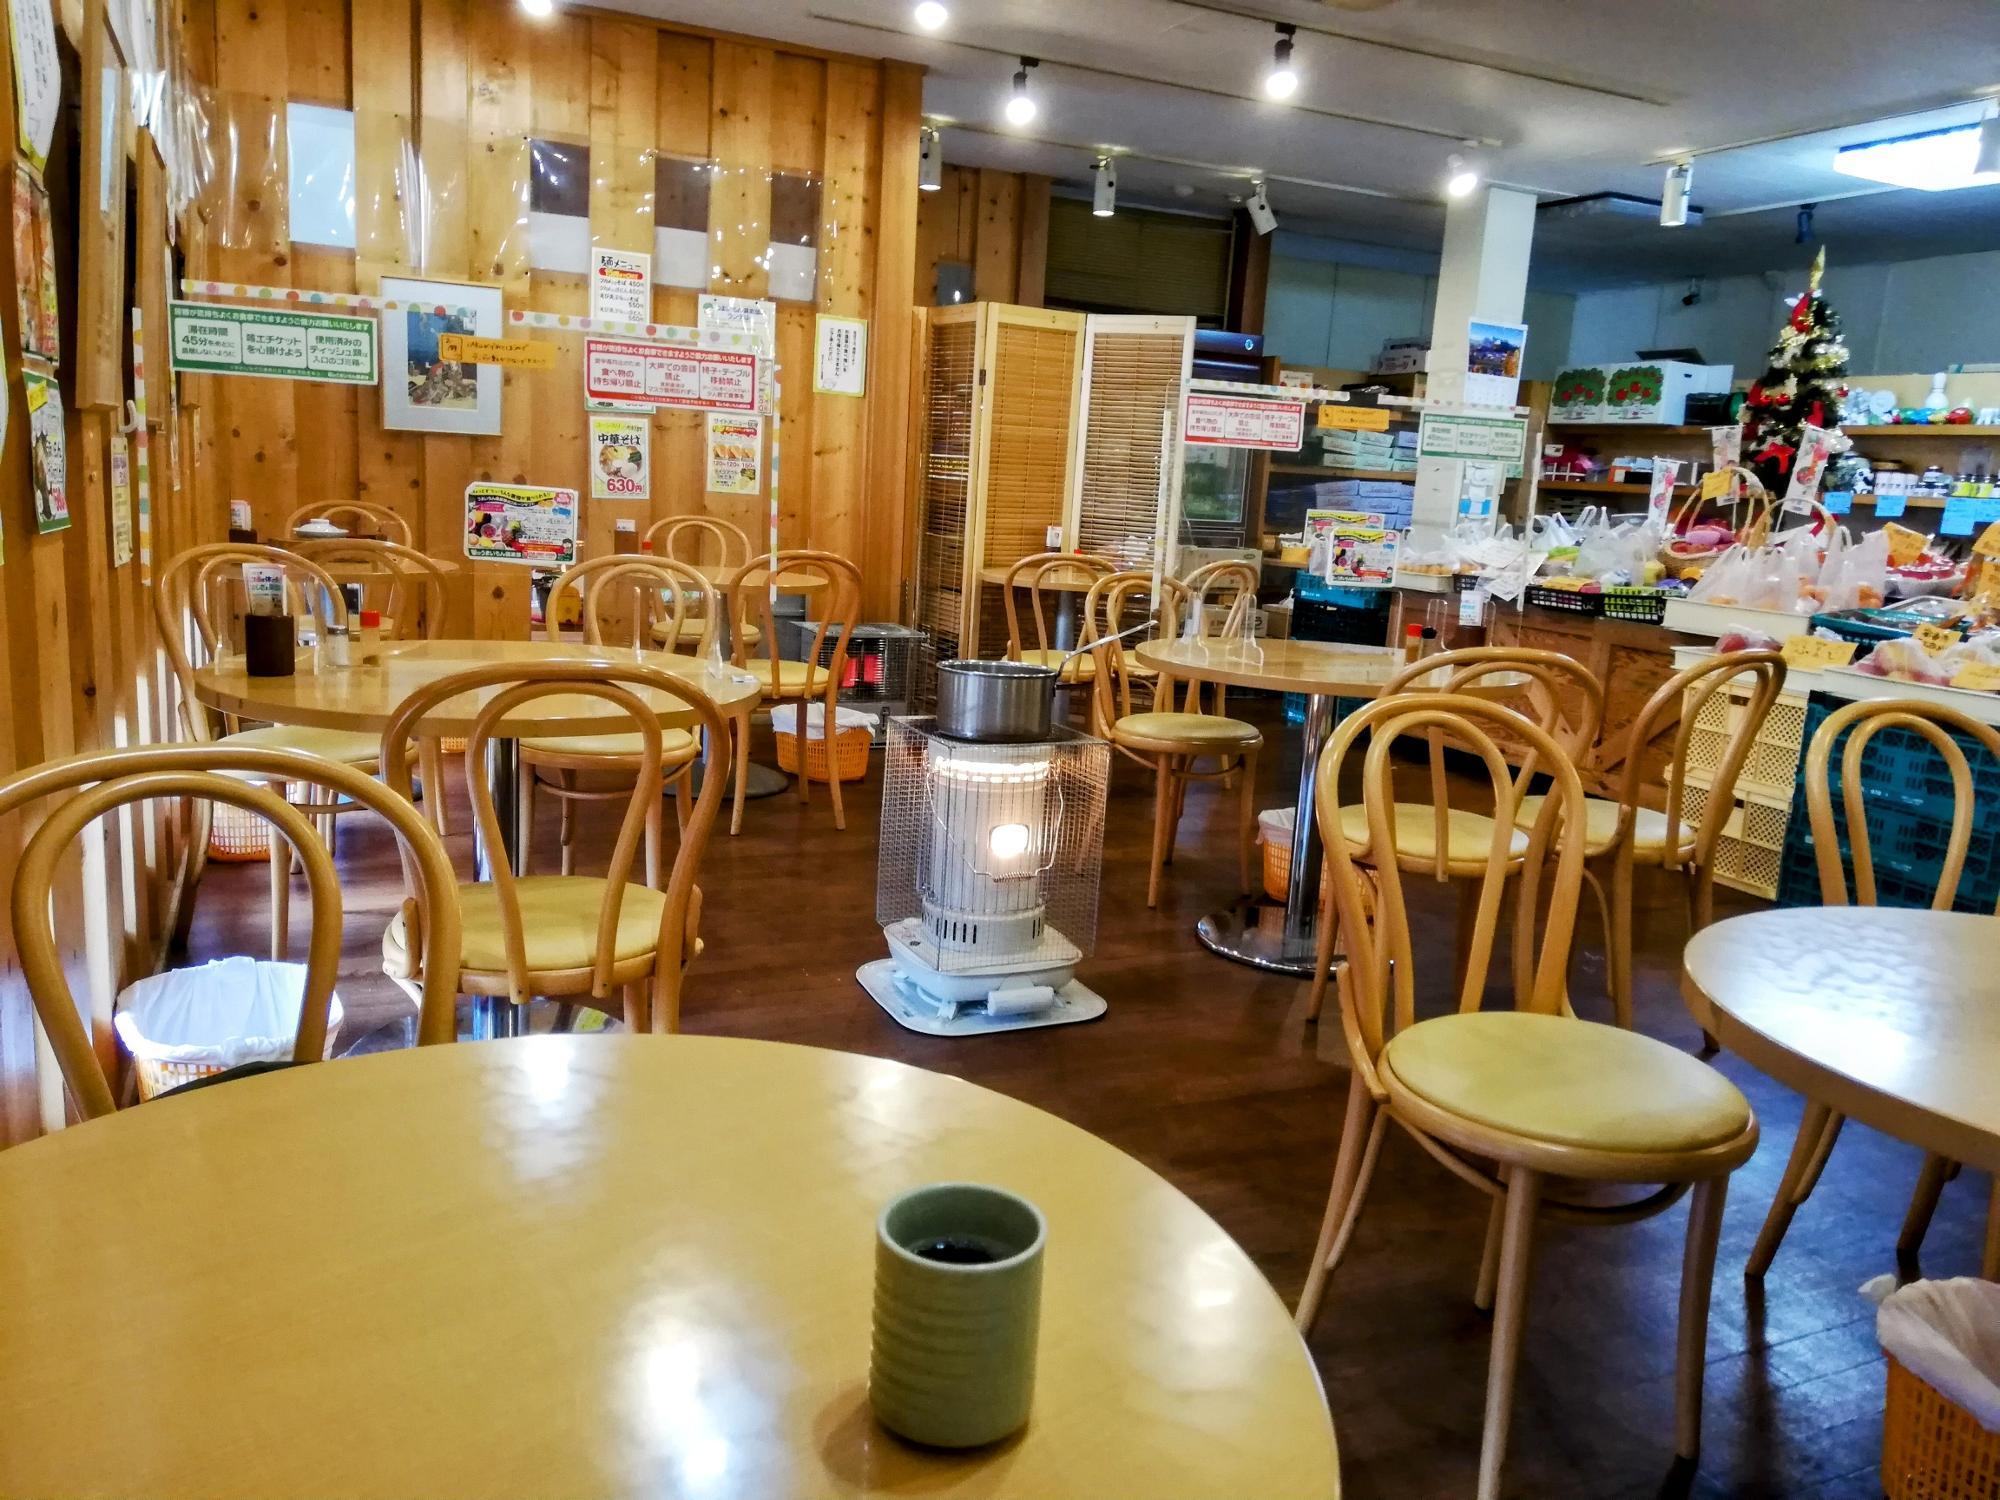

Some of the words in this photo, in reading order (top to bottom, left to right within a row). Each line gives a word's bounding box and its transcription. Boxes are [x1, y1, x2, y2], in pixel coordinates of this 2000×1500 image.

[601, 256, 641, 270] 麺メニュー
[188, 325, 229, 337] 滞在時間
[315, 335, 362, 347] 使用済みの
[246, 344, 303, 358] を心掛けよう
[309, 345, 368, 358] ティッシュ類は
[313, 356, 366, 368] 入口のゴミ箱へ
[648, 362, 697, 374] 大声での会話
[601, 368, 634, 378] 食べ物の
[665, 372, 681, 382] 禁止
[702, 366, 750, 379] 椅子・テーブル
[593, 377, 642, 388] 持ち帰り禁止
[710, 376, 742, 387] 移動禁止
[597, 433, 641, 446] 中華そば
[607, 478, 643, 494] 630円
